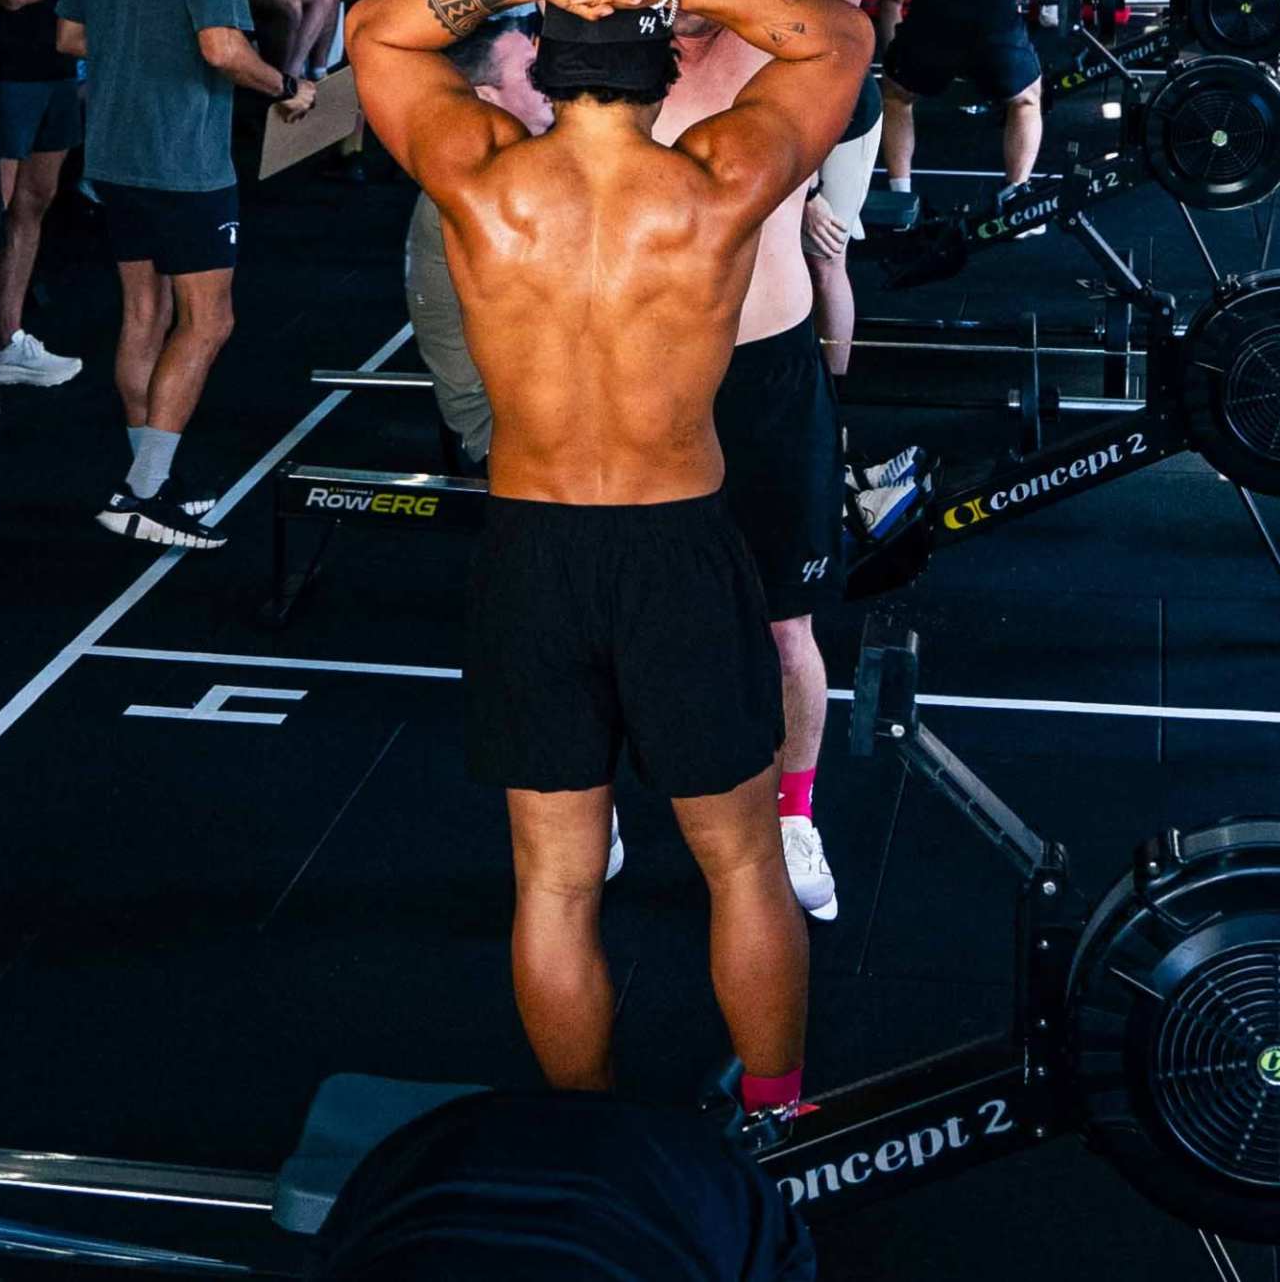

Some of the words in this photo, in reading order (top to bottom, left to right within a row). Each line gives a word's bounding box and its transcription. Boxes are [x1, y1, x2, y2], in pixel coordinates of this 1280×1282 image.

[1086, 45, 1156, 78] cocept
[1159, 35, 1169, 47] 2
[1010, 178, 1103, 226] conct
[1105, 172, 1120, 187] 2
[989, 445, 1124, 511] concept
[1128, 432, 1148, 454] 2
[305, 487, 440, 516] RowERG
[777, 1116, 969, 1206] oncept
[977, 1098, 1014, 1134] 2
